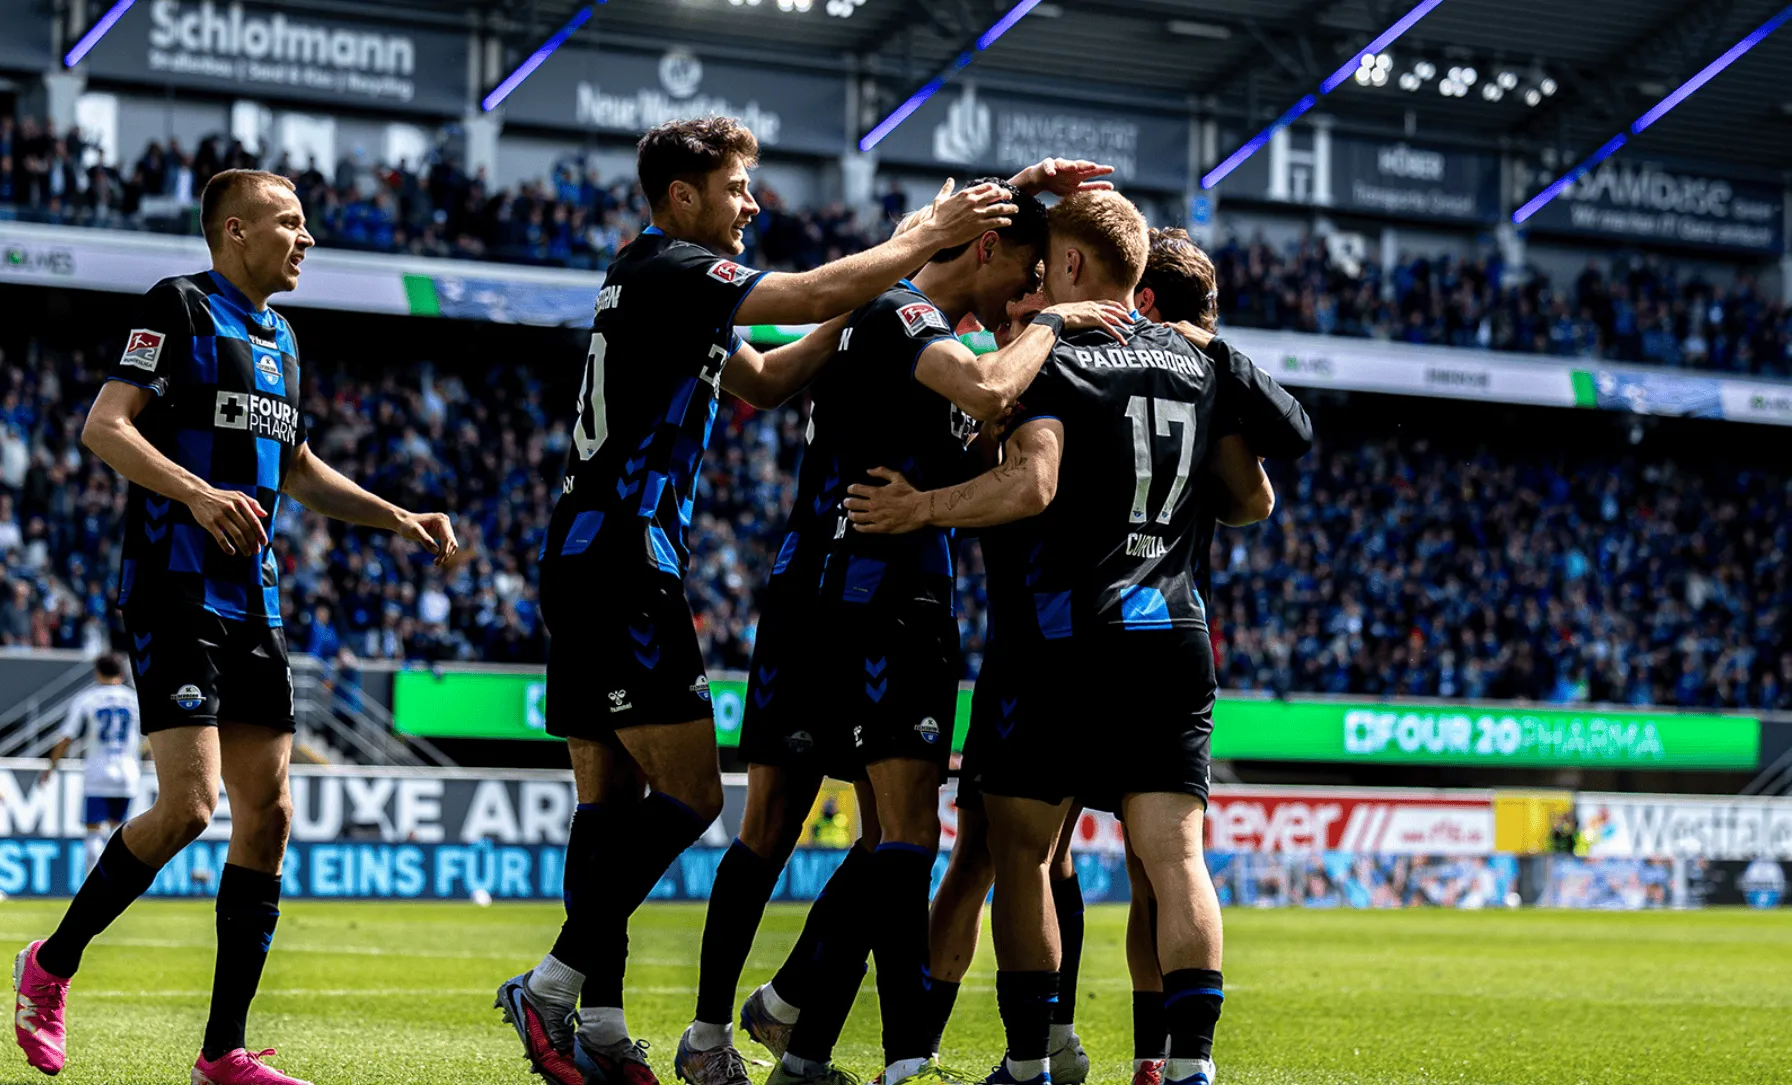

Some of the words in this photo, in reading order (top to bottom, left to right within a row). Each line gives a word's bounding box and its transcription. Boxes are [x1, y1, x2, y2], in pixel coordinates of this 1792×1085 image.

[150, 0, 414, 75] Schlotmann
[1075, 349, 1204, 377] PADERBORN
[250, 394, 291, 423] FOUR
[1124, 395, 1197, 525] 17
[310, 843, 427, 897] EINS
[435, 839, 533, 897] FÜR
